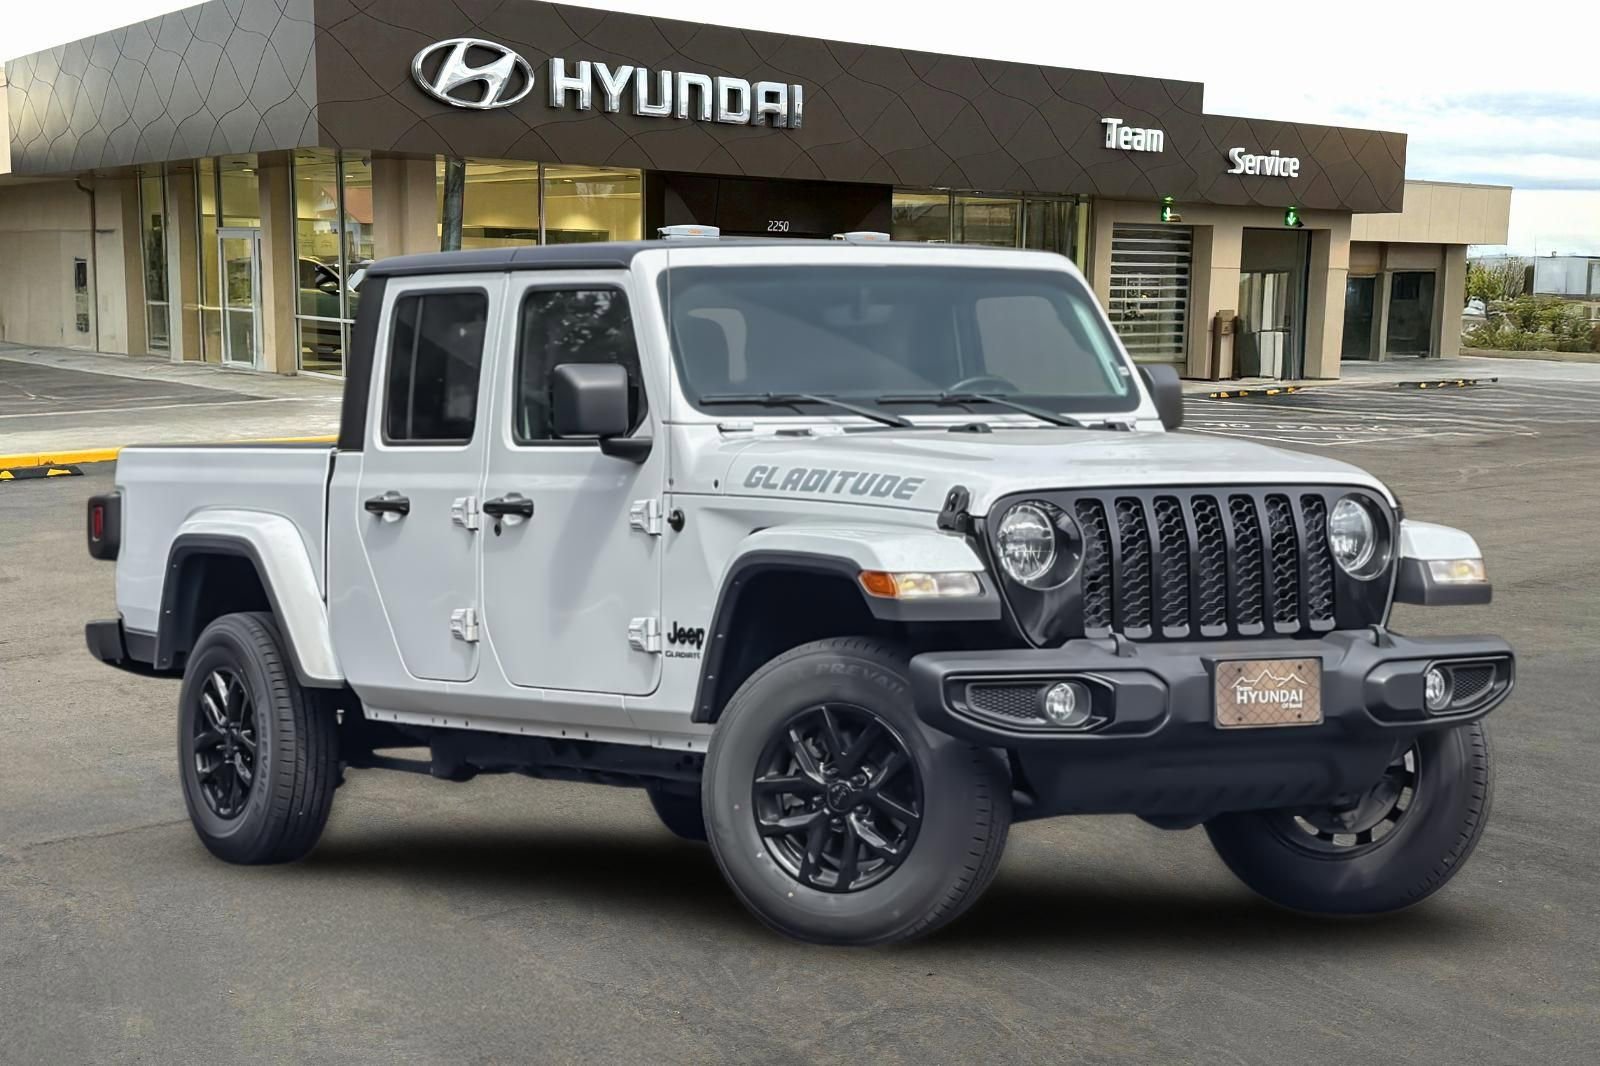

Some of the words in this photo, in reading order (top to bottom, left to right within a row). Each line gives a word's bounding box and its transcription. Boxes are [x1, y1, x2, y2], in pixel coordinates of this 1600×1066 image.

[549, 57, 803, 129] HYUNDAI
[1101, 117, 1164, 152] Team
[1227, 147, 1300, 177] Service
[767, 220, 790, 232] 2250
[743, 465, 926, 500] GLADITUDE
[667, 621, 705, 650] Jeep
[1236, 688, 1304, 704] HYUNDAI
